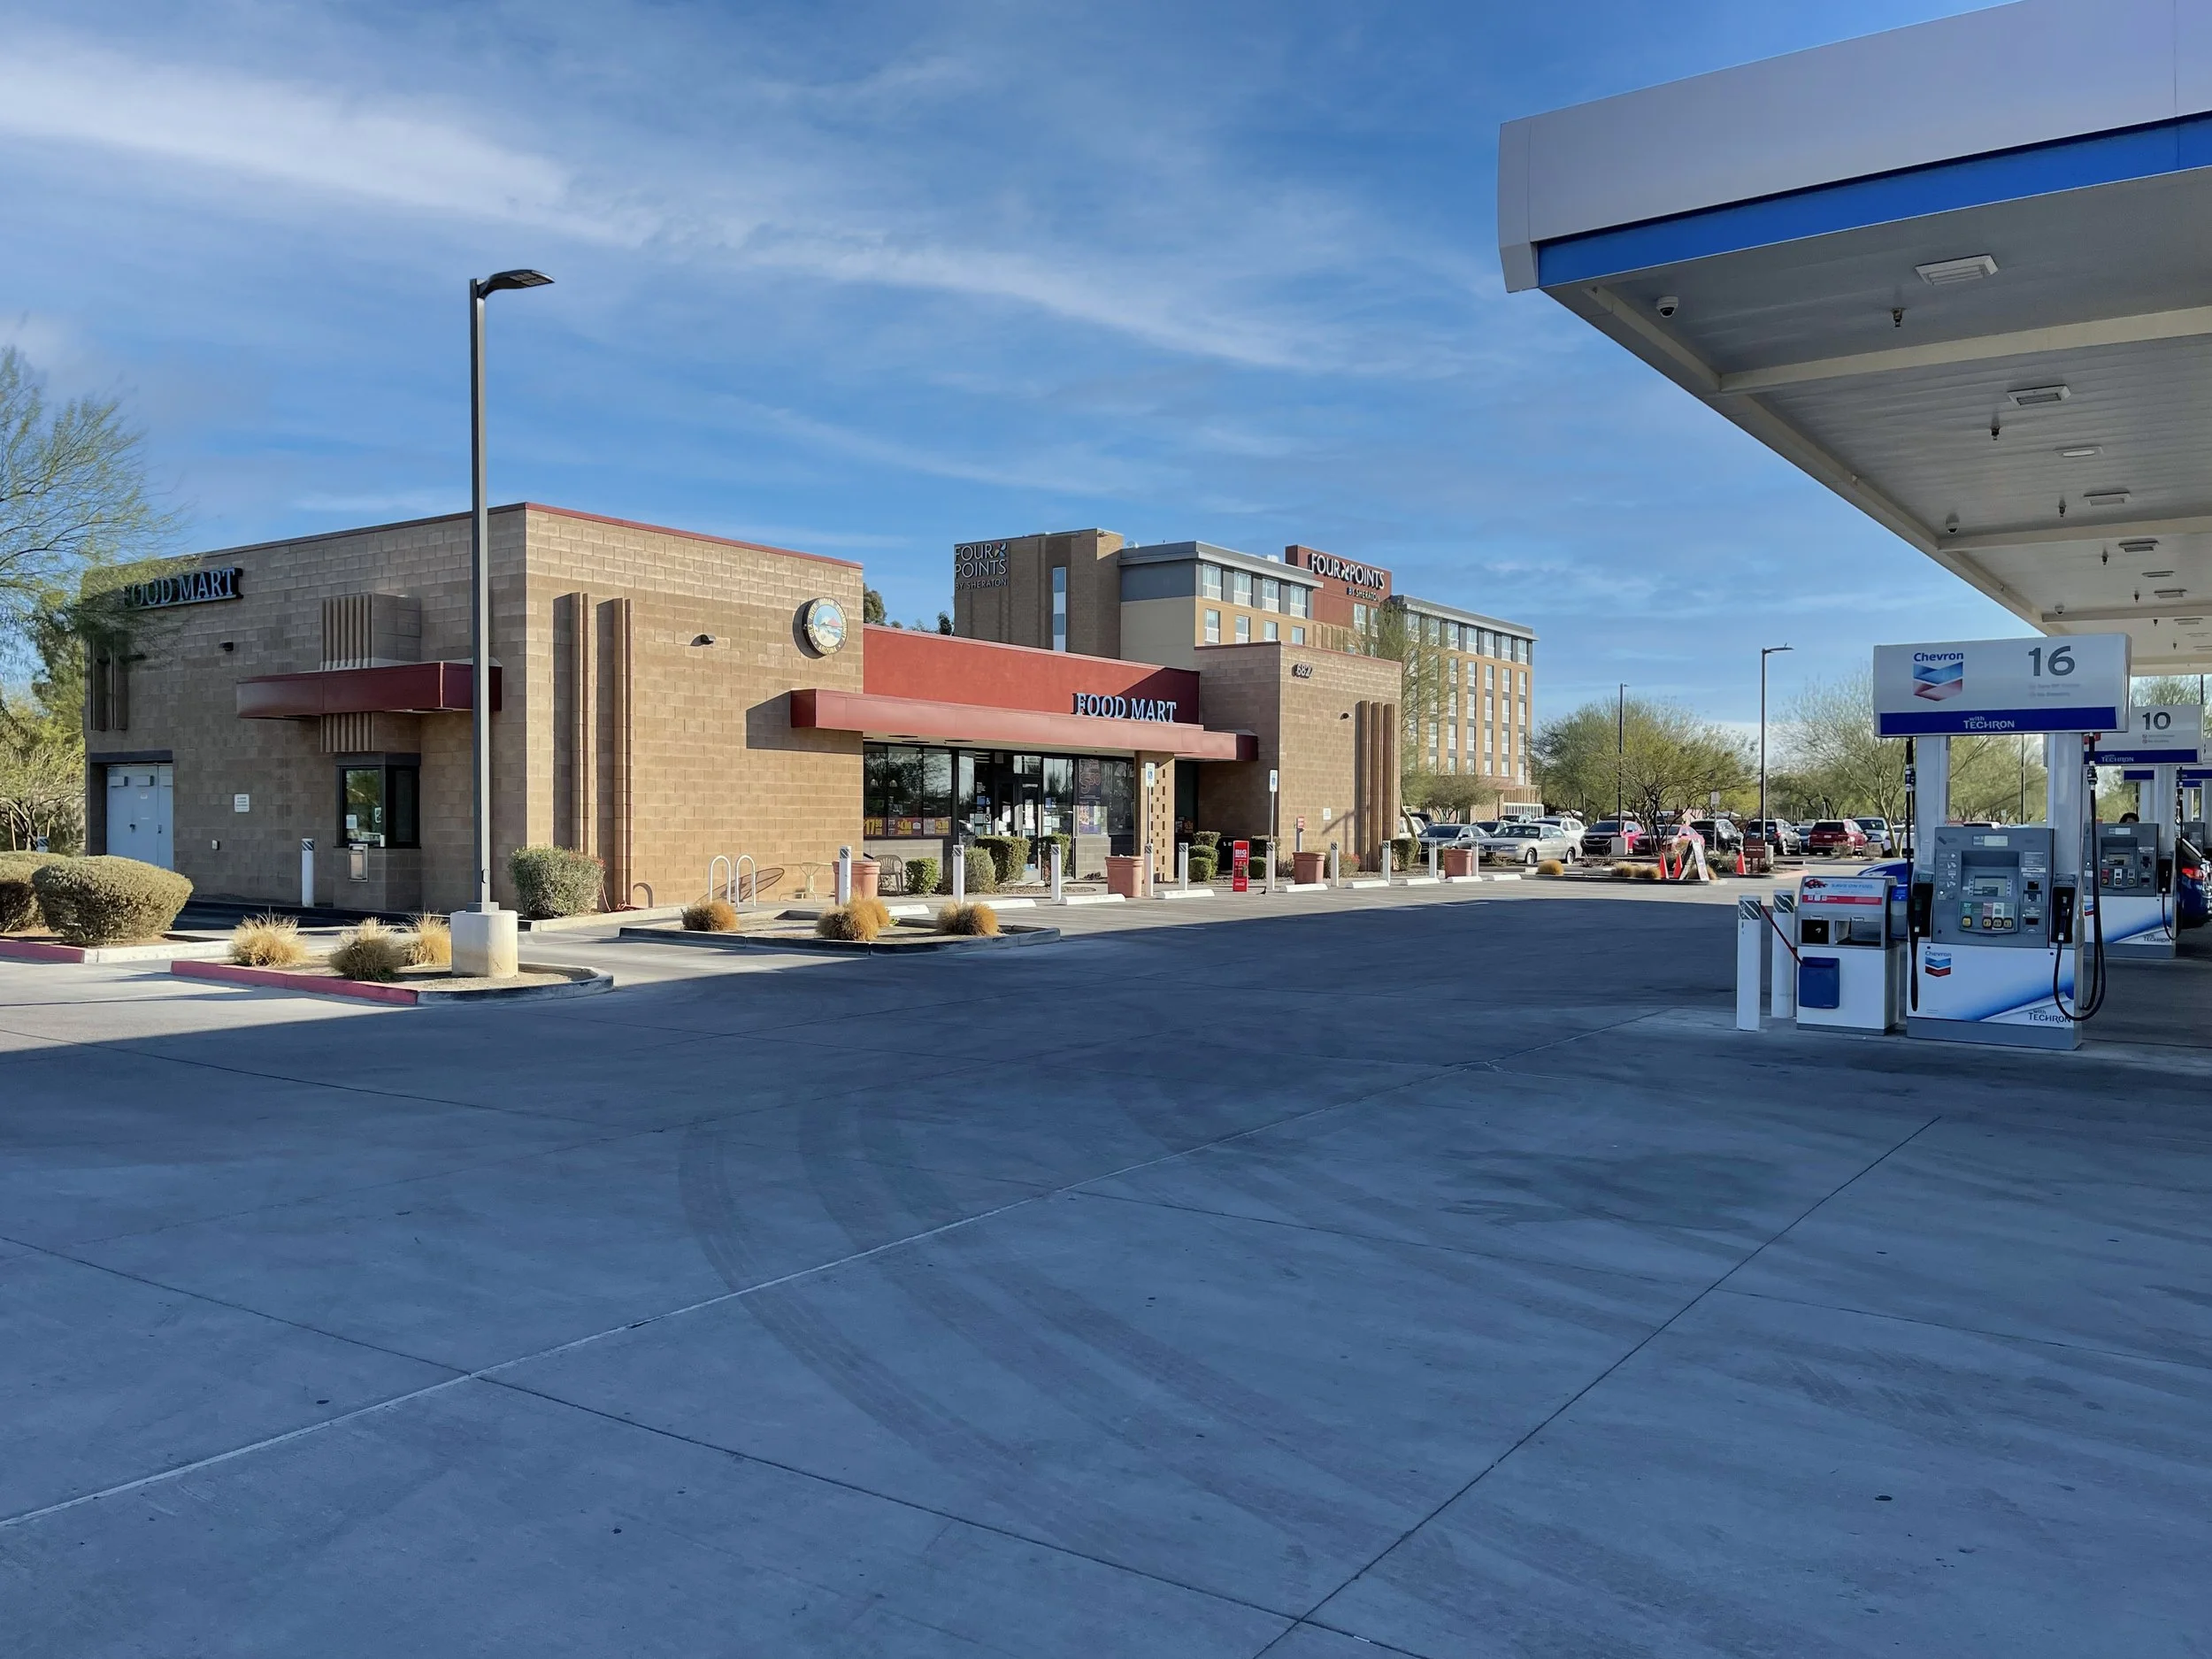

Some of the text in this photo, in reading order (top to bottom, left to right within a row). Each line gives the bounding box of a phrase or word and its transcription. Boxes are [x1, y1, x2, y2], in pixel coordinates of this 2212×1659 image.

[955, 543, 994, 561] FOUR
[955, 558, 1007, 578] POINTS
[1310, 553, 1385, 590] FOUR POINTS
[178, 567, 236, 603] MART
[955, 578, 1008, 590] BY SHERATON
[1913, 652, 1964, 662] Chevron
[2028, 645, 2076, 677] 16
[1075, 692, 1177, 723] FOOD MART
[1962, 719, 2016, 730] TECHRON
[2142, 711, 2171, 731] 10
[2028, 1011, 2071, 1024] TECHRON
